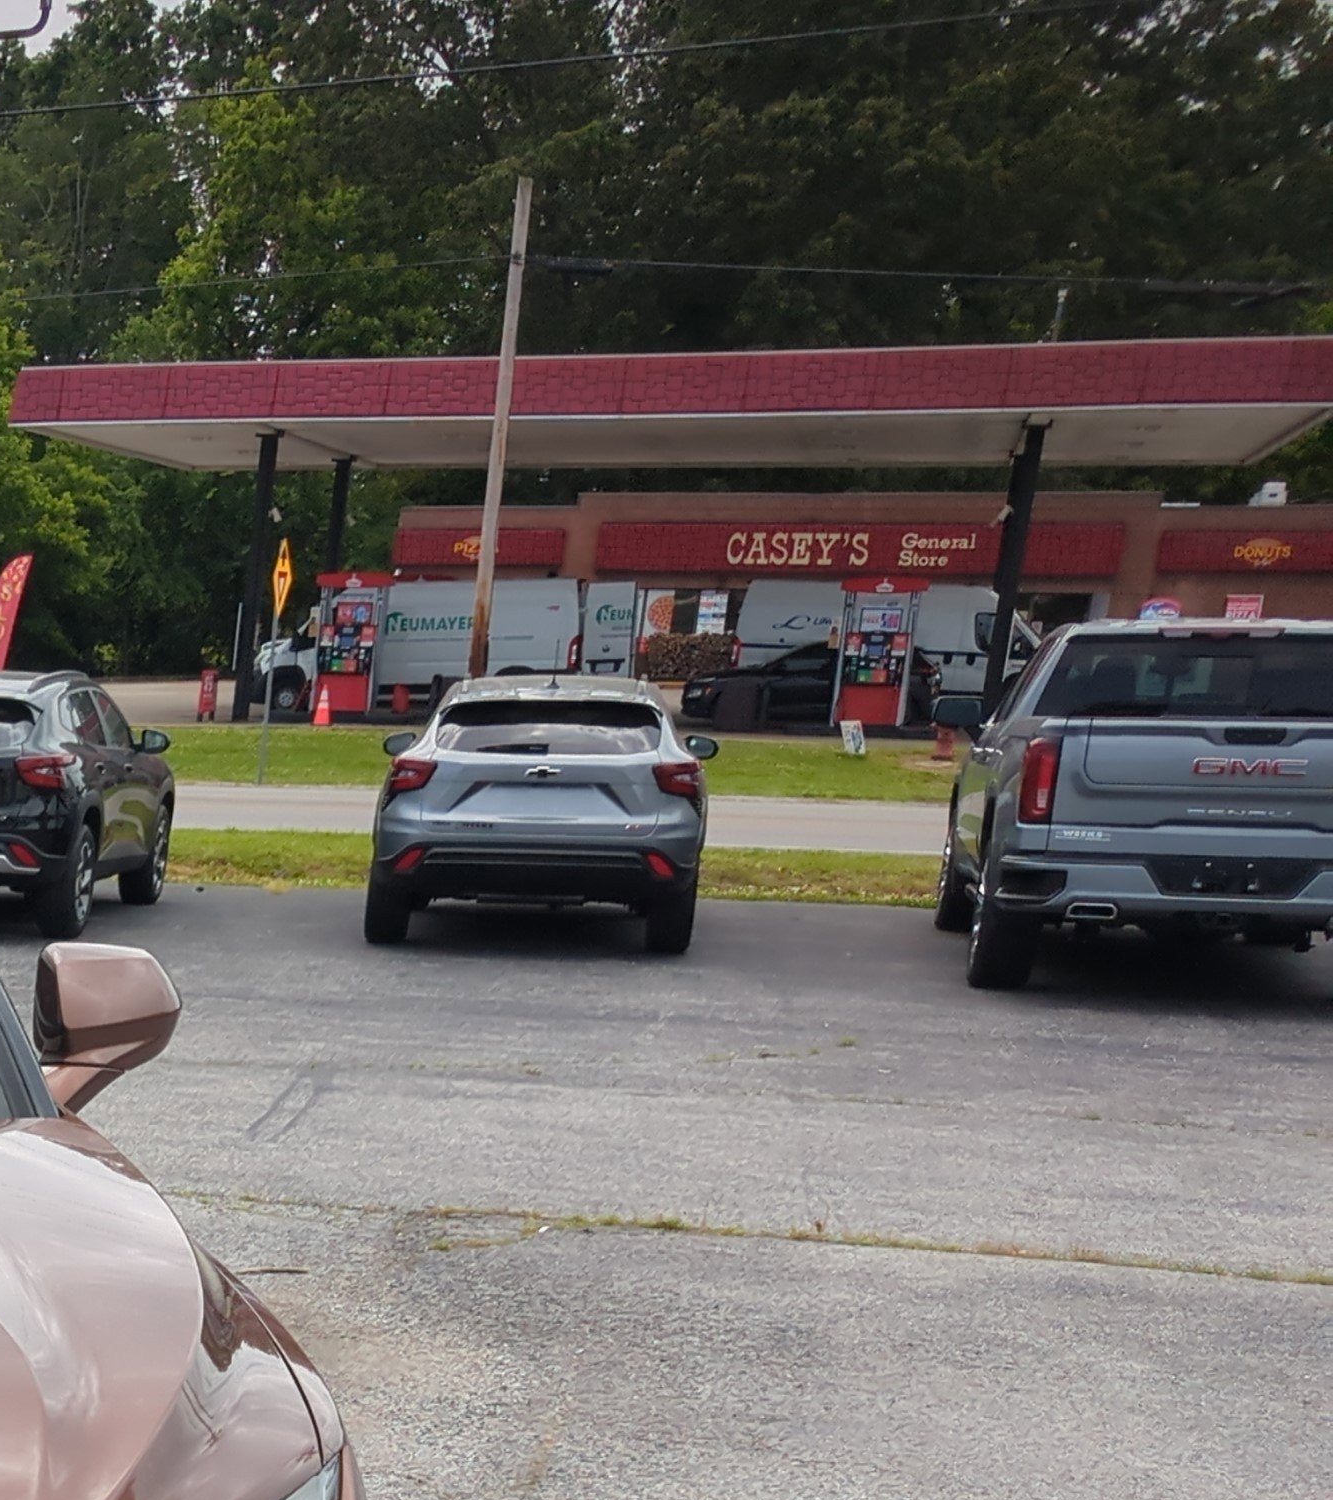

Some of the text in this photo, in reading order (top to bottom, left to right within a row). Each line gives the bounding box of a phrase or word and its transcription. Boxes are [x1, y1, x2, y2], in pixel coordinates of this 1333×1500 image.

[726, 532, 978, 566] CASEY'S General
[1234, 546, 1291, 558] DONUTS
[898, 551, 949, 567] Store
[1193, 757, 1308, 775] GMC
